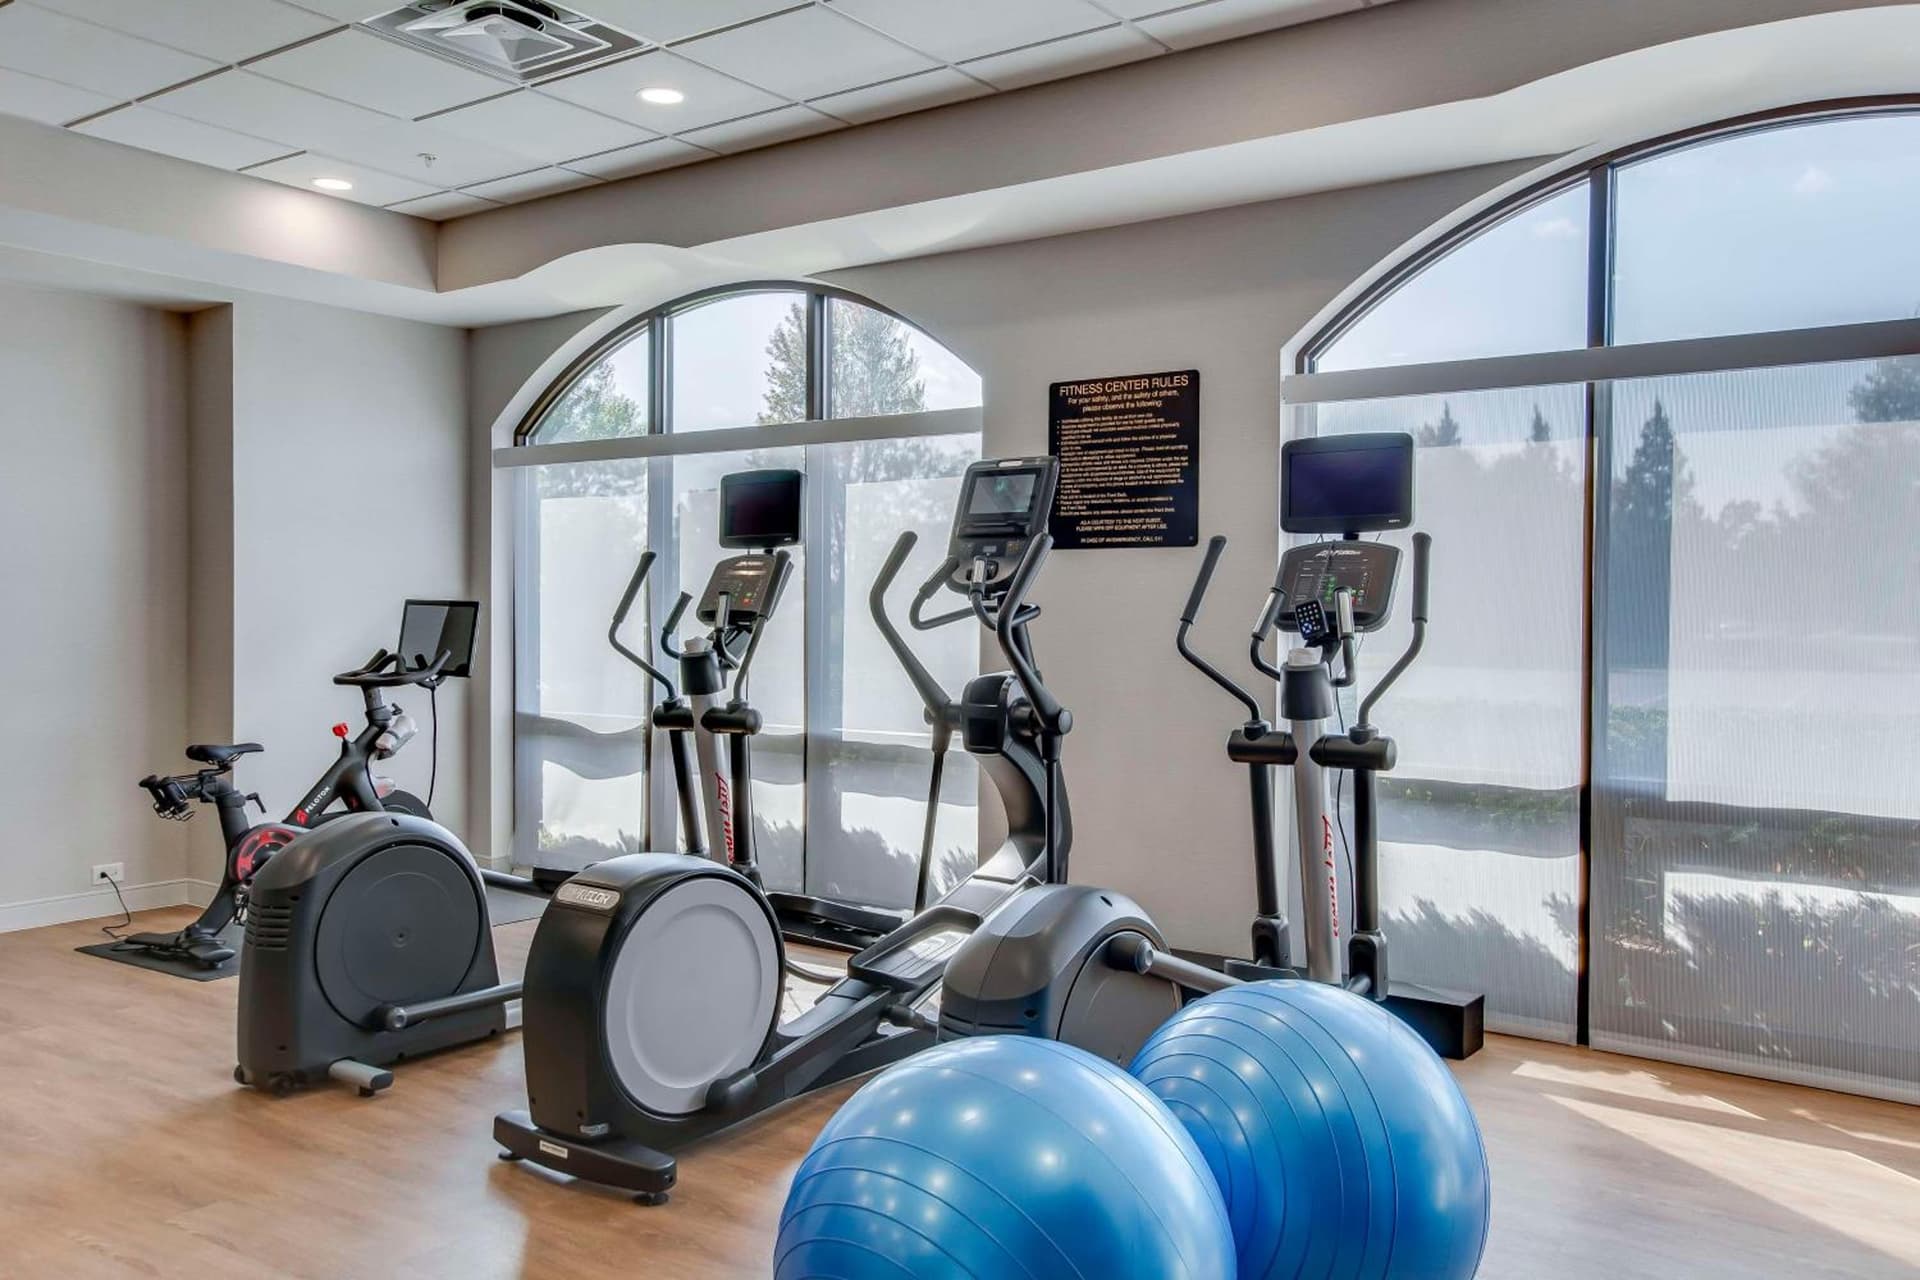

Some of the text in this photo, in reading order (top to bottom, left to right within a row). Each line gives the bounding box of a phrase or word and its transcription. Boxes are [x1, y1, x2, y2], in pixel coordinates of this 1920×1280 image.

[1059, 374, 1189, 397] FITNESS CENTER RULES
[1078, 398, 1091, 407] your
[1092, 395, 1109, 404] safety,
[1134, 392, 1151, 401] safety
[1082, 404, 1102, 415] please
[1102, 402, 1125, 410] observe
[304, 786, 330, 814] PELOTON
